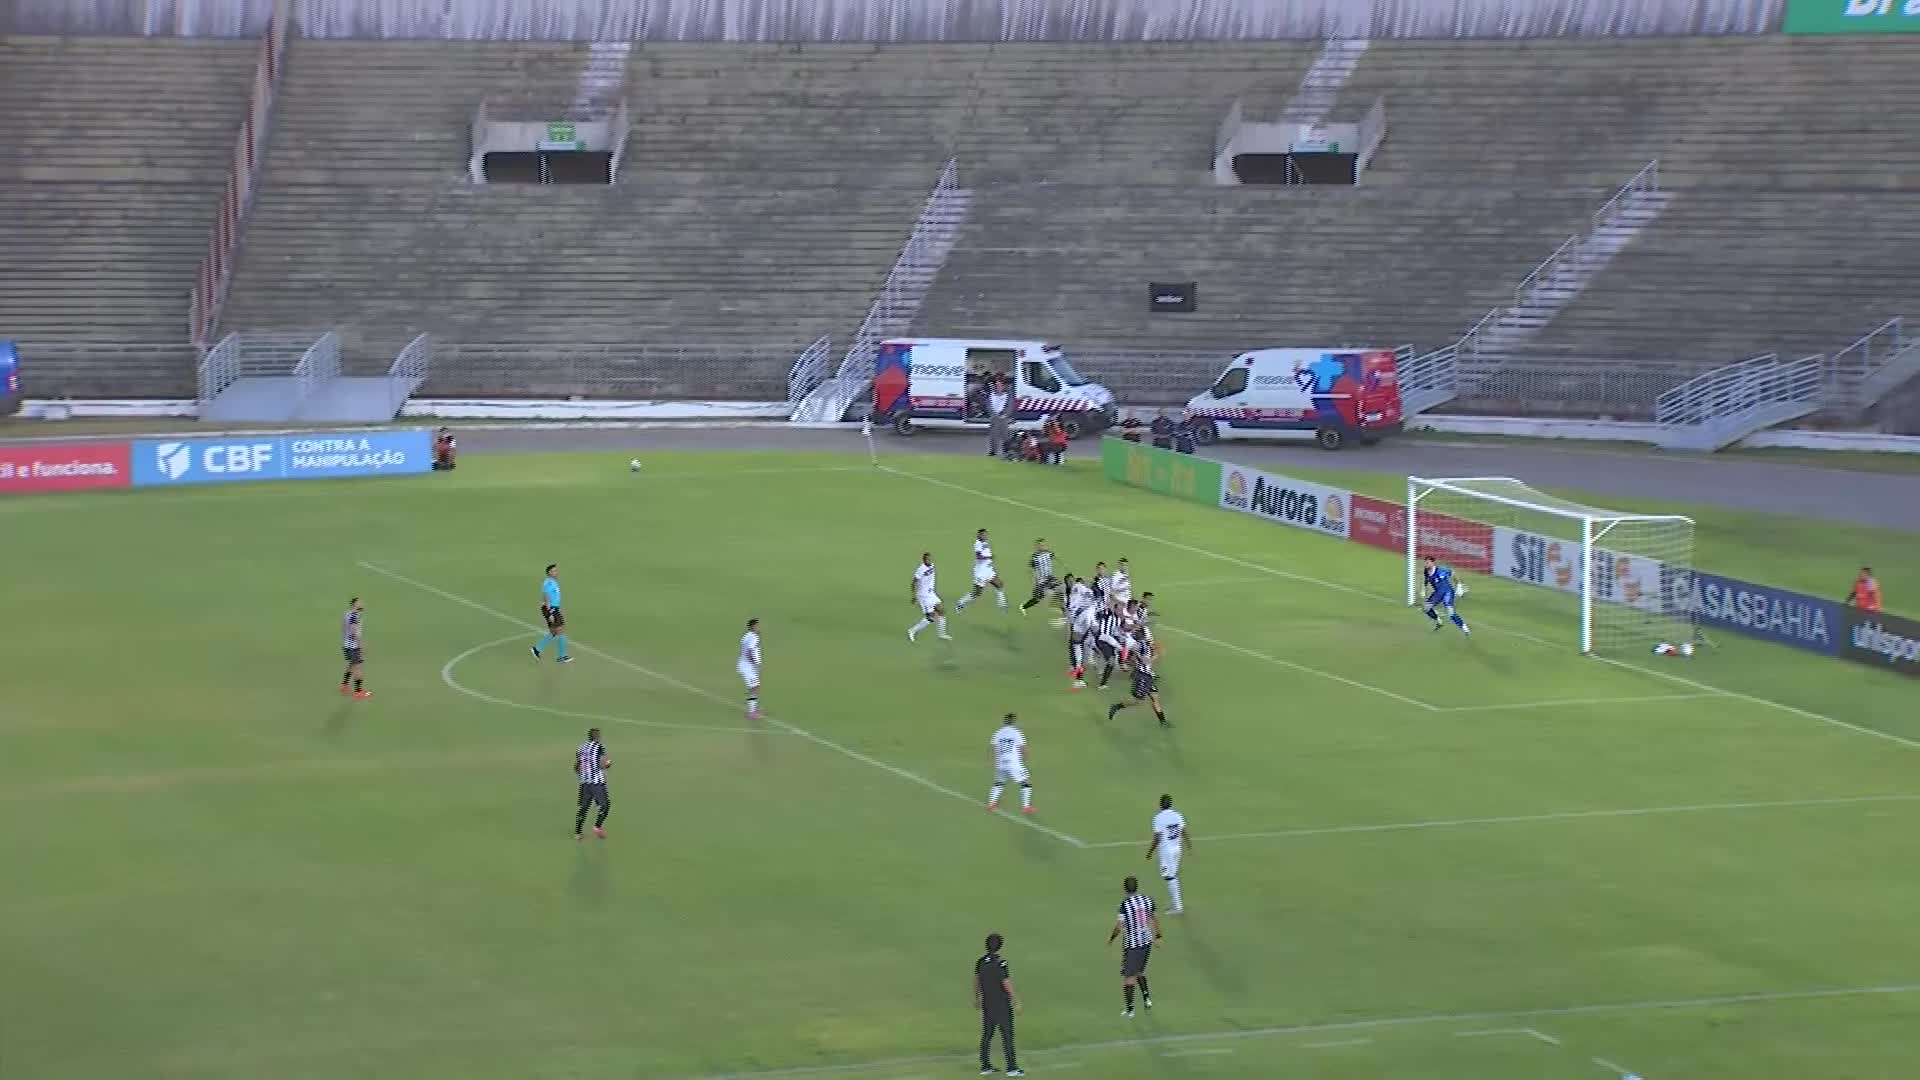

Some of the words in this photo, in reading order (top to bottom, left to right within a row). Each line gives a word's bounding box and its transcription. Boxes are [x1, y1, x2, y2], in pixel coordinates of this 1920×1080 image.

[910, 362, 964, 377] moove
[1253, 375, 1296, 385] moove
[292, 440, 354, 454] CONTRA
[359, 438, 370, 451] A
[203, 444, 272, 473] CBF
[292, 449, 405, 469] MANIPULAÇÃO
[17, 464, 29, 478] e
[33, 459, 118, 477] funciona.
[1251, 475, 1318, 525] Aurora
[1511, 533, 1546, 583] Sil
[1000, 738, 1014, 755] 17
